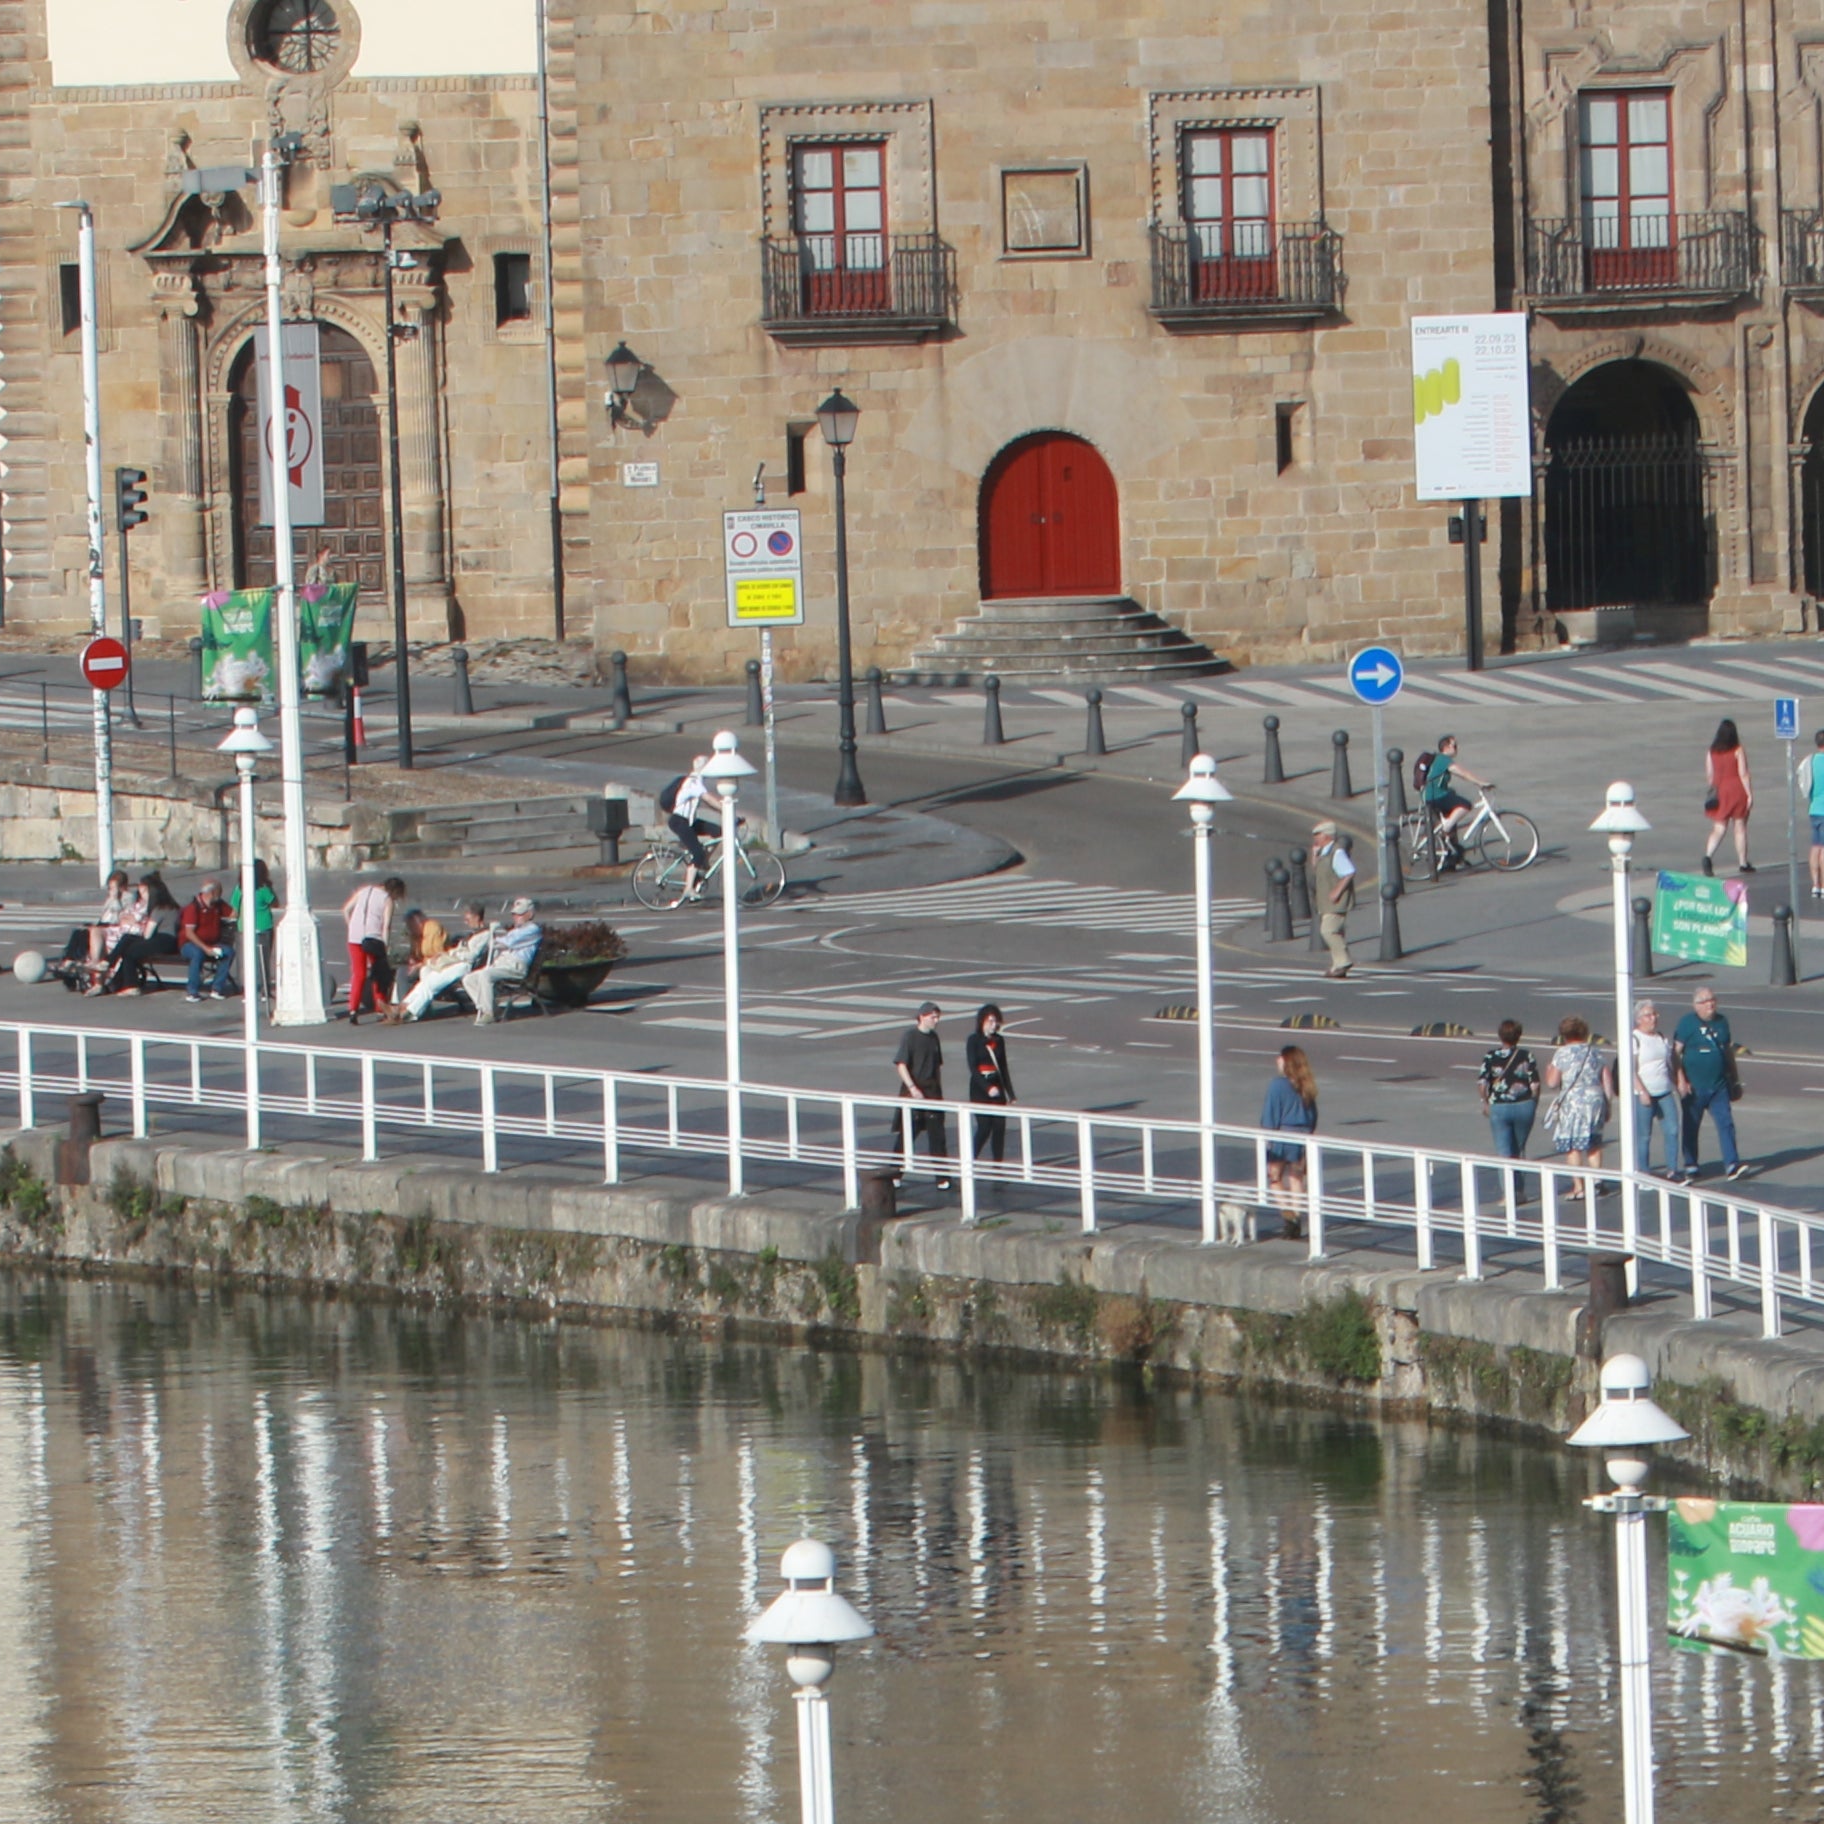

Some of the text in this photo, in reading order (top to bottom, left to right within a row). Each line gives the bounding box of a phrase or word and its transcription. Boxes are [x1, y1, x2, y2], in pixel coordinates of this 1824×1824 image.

[1415, 326, 1459, 335] ENTREARTE
[1474, 334, 1516, 344] 22.09.23
[1474, 345, 1516, 356] 22.10.23
